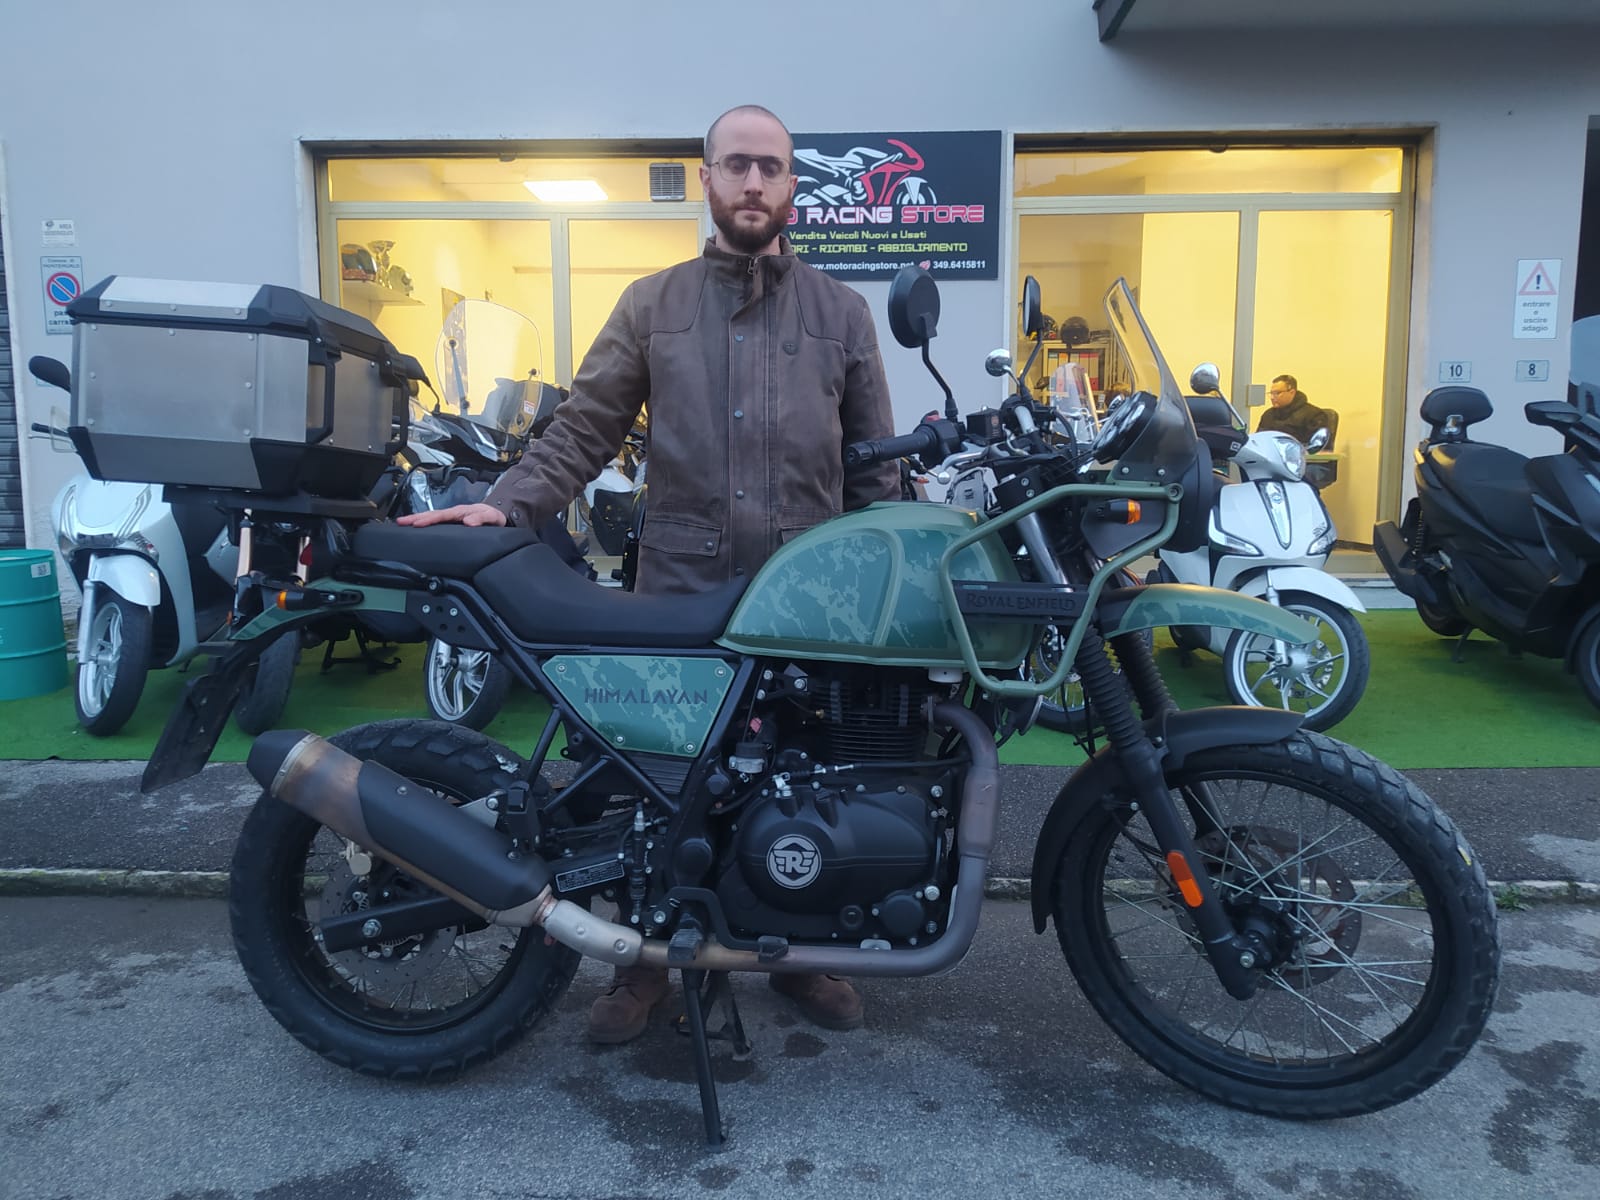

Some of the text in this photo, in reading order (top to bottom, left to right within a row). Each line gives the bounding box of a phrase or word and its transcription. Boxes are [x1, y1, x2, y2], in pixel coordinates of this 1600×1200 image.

[806, 206, 893, 224] RACING
[901, 205, 984, 223] STORE
[789, 231, 827, 240] Vendita
[829, 230, 859, 240] Veicoli
[861, 230, 889, 239] Nuovi
[900, 230, 927, 239] Usati
[819, 243, 868, 253] RICAMBI
[878, 243, 968, 253] ABBIGLIAMENTO
[933, 260, 986, 269] 349.6415811
[1521, 325, 1549, 333] adagio
[1449, 364, 1463, 377] 10
[1528, 363, 1536, 376] 8
[966, 593, 1076, 611] ROYAL ENFIELD
[584, 687, 708, 704] HIMALAYAN
